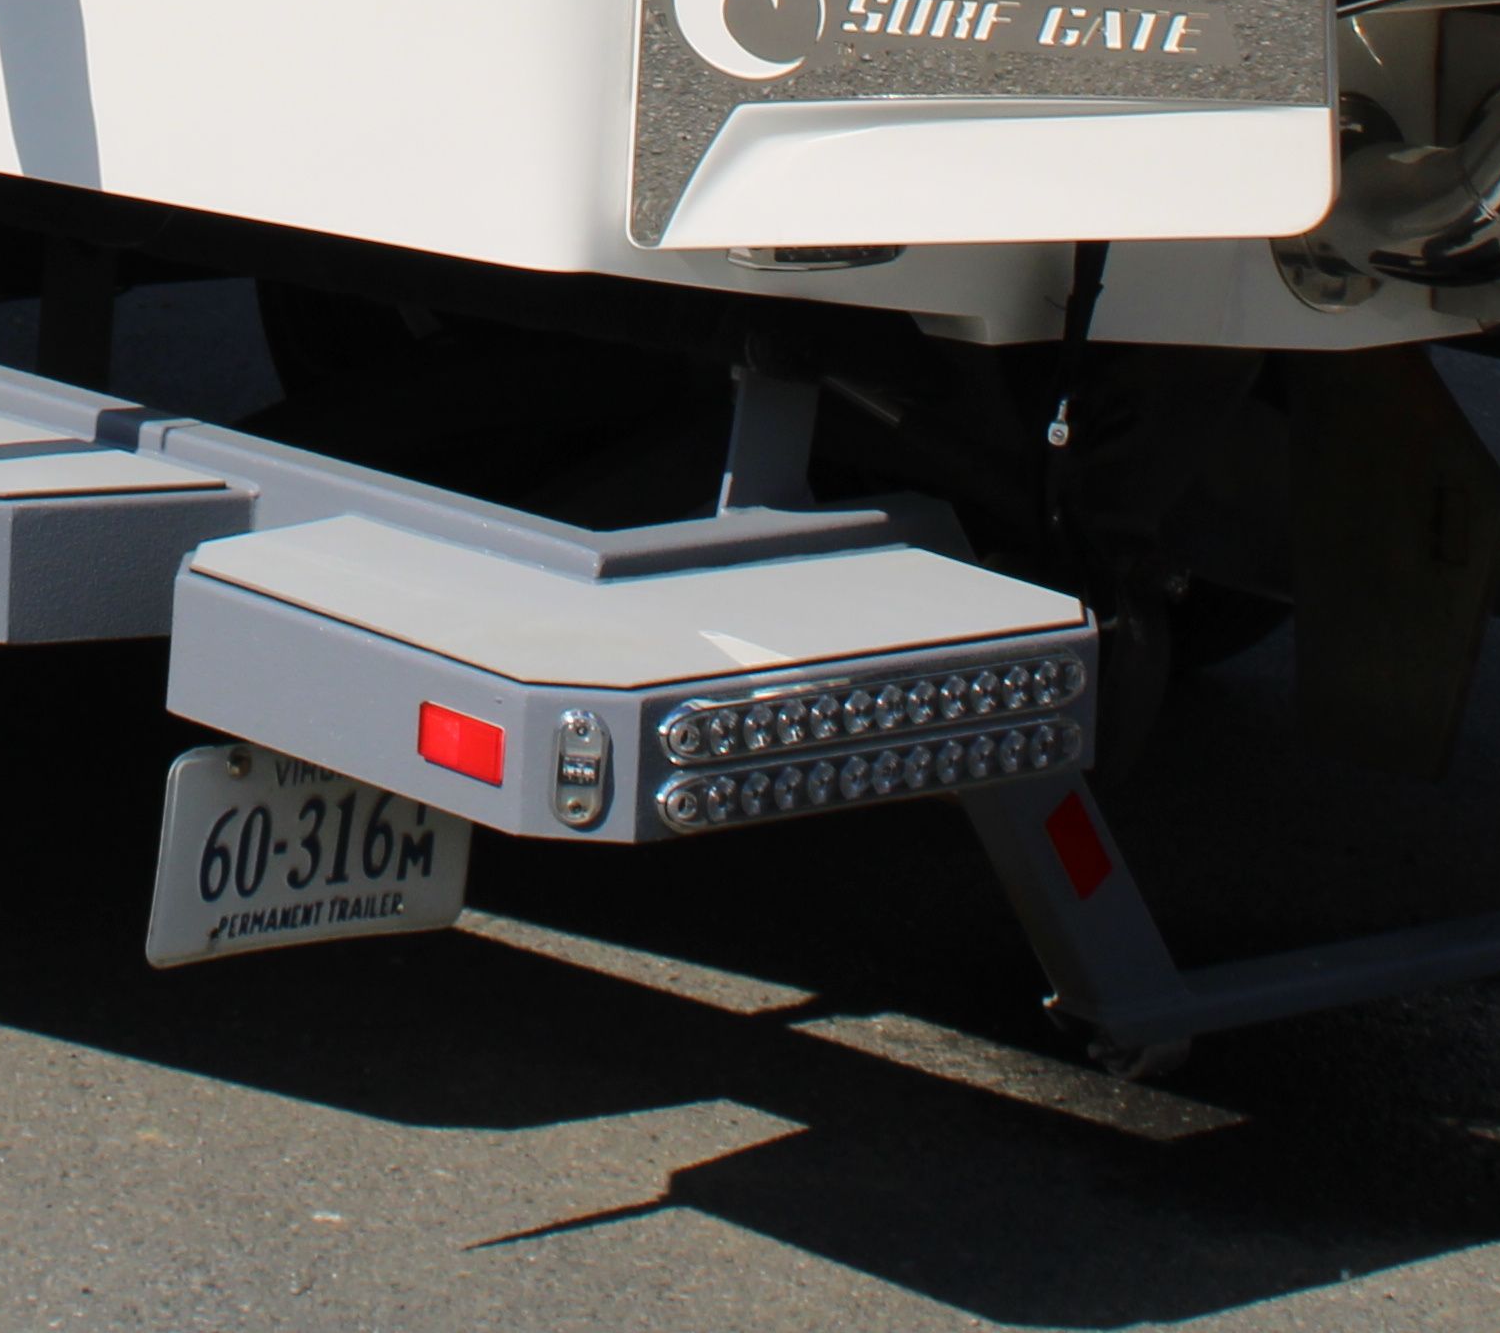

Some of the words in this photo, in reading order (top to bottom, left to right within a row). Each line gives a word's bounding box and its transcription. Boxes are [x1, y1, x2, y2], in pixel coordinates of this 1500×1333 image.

[1037, 4, 1212, 55] GATE
[217, 899, 324, 940] PERMANENT
[328, 891, 404, 924] TRAILER
